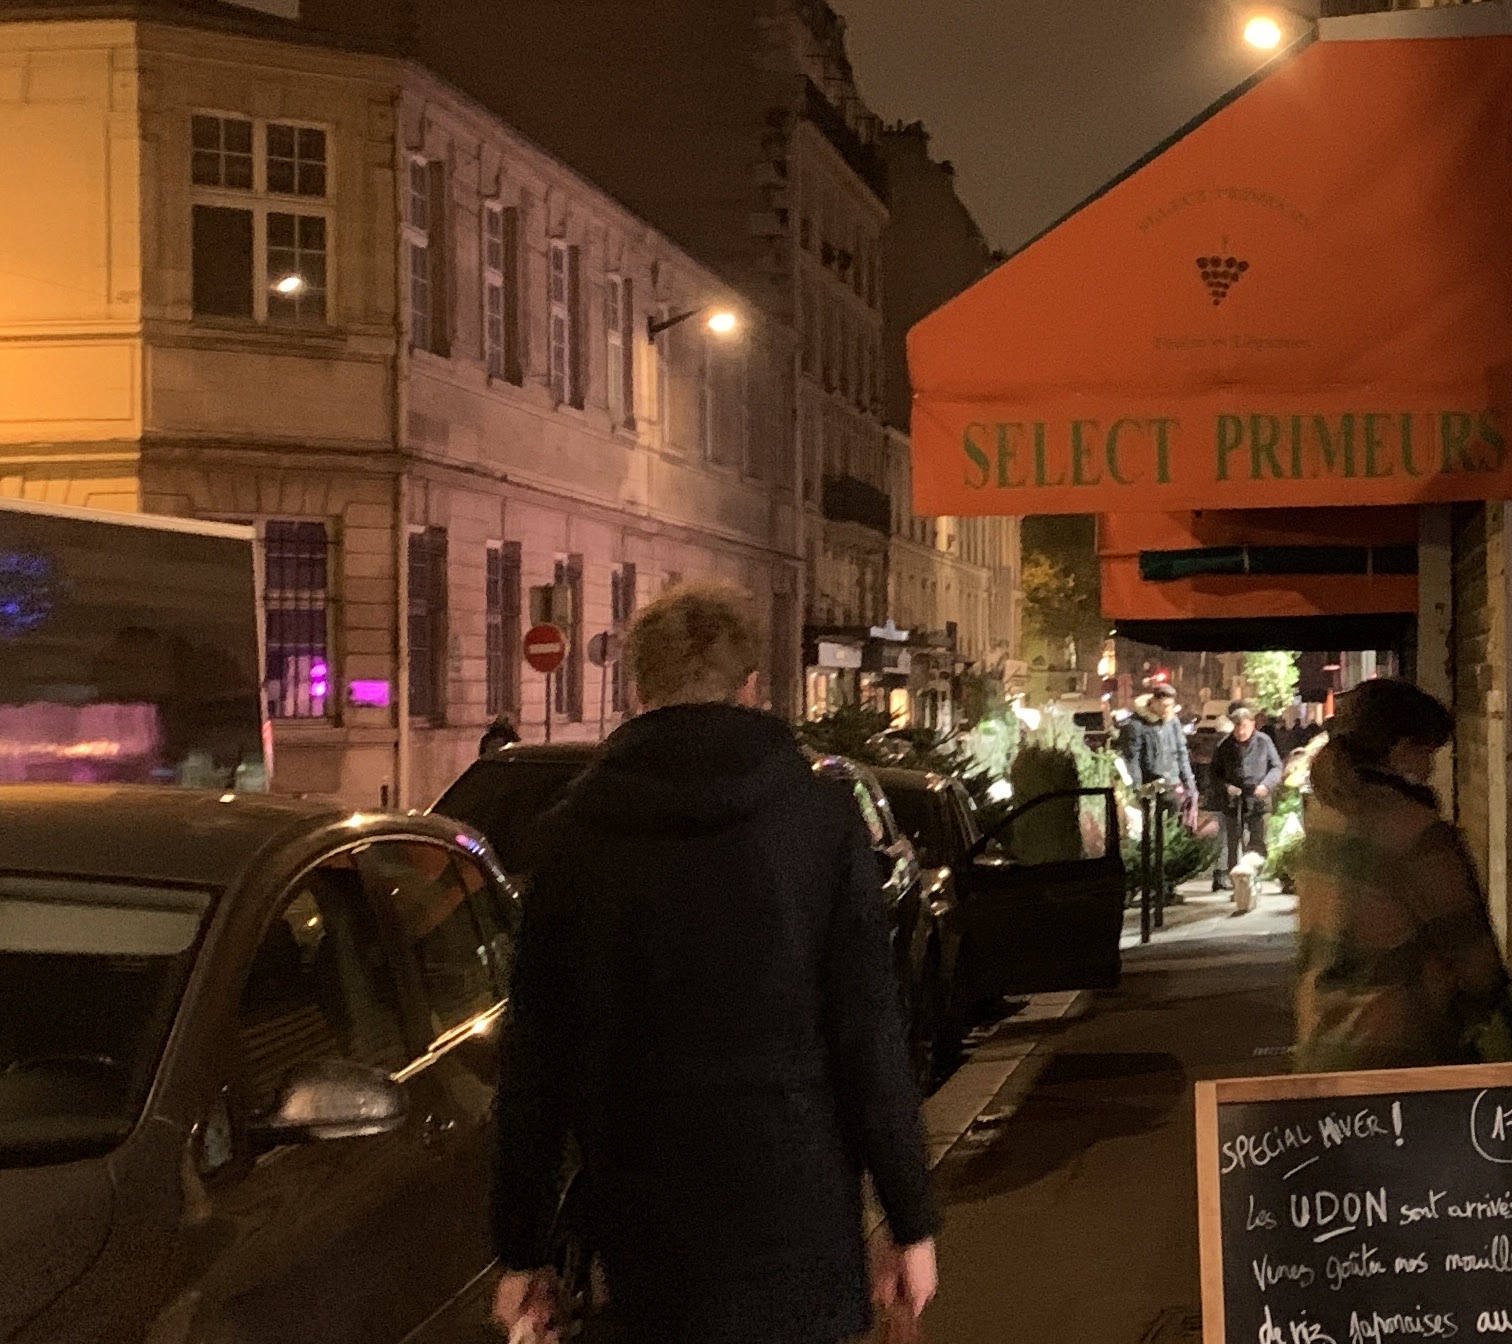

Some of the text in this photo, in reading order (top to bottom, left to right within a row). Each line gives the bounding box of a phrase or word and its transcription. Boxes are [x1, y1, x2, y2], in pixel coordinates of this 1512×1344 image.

[962, 408, 1510, 490] SELECT PRIMEURS
[1246, 1194, 1278, 1231] Les
[1290, 1186, 1388, 1228] UDON
[1400, 1189, 1447, 1225] sont
[1252, 1254, 1315, 1292] Venez
[1395, 1252, 1428, 1274] nos
